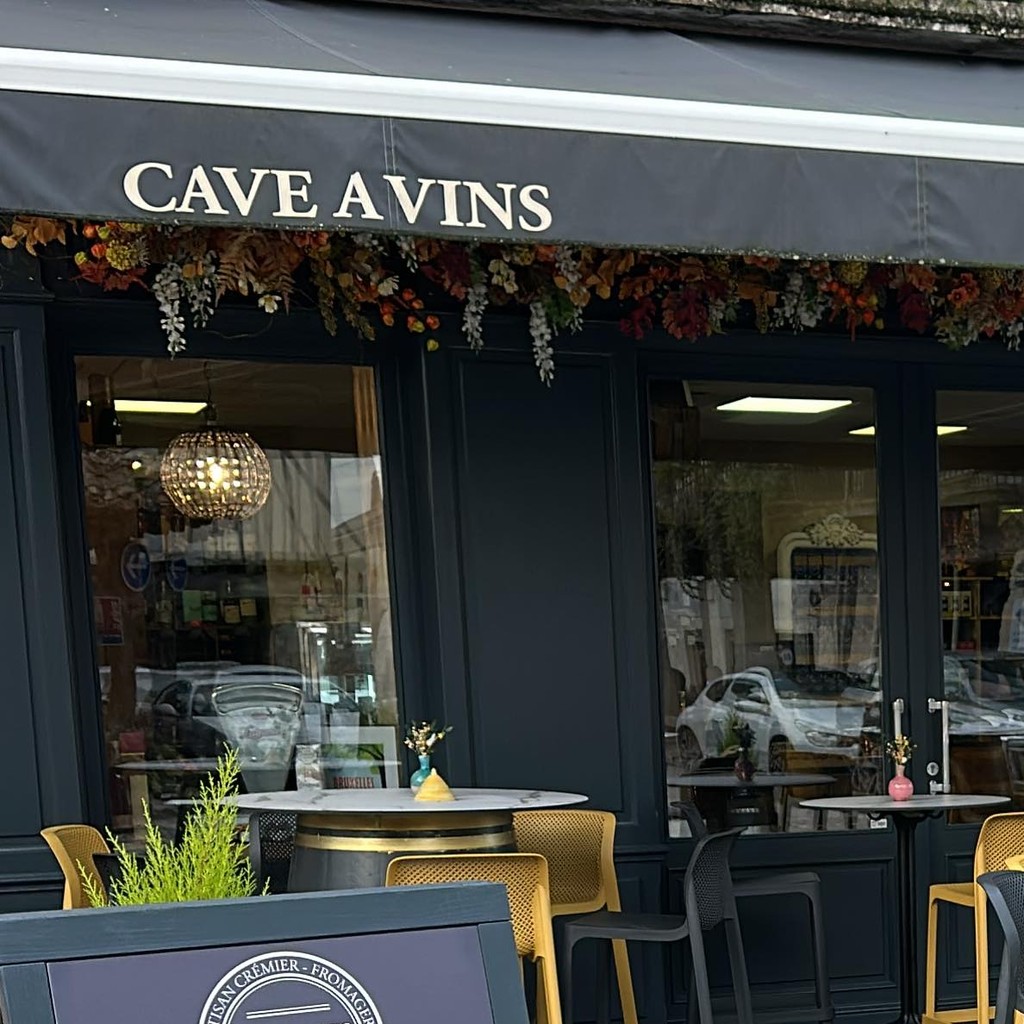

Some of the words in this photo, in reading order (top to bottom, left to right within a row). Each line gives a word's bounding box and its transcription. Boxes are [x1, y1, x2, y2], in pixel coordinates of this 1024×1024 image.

[124, 163, 318, 218] CAVE
[333, 172, 385, 221] A
[383, 175, 553, 232] VINS
[234, 959, 300, 988] CRÉMIER
